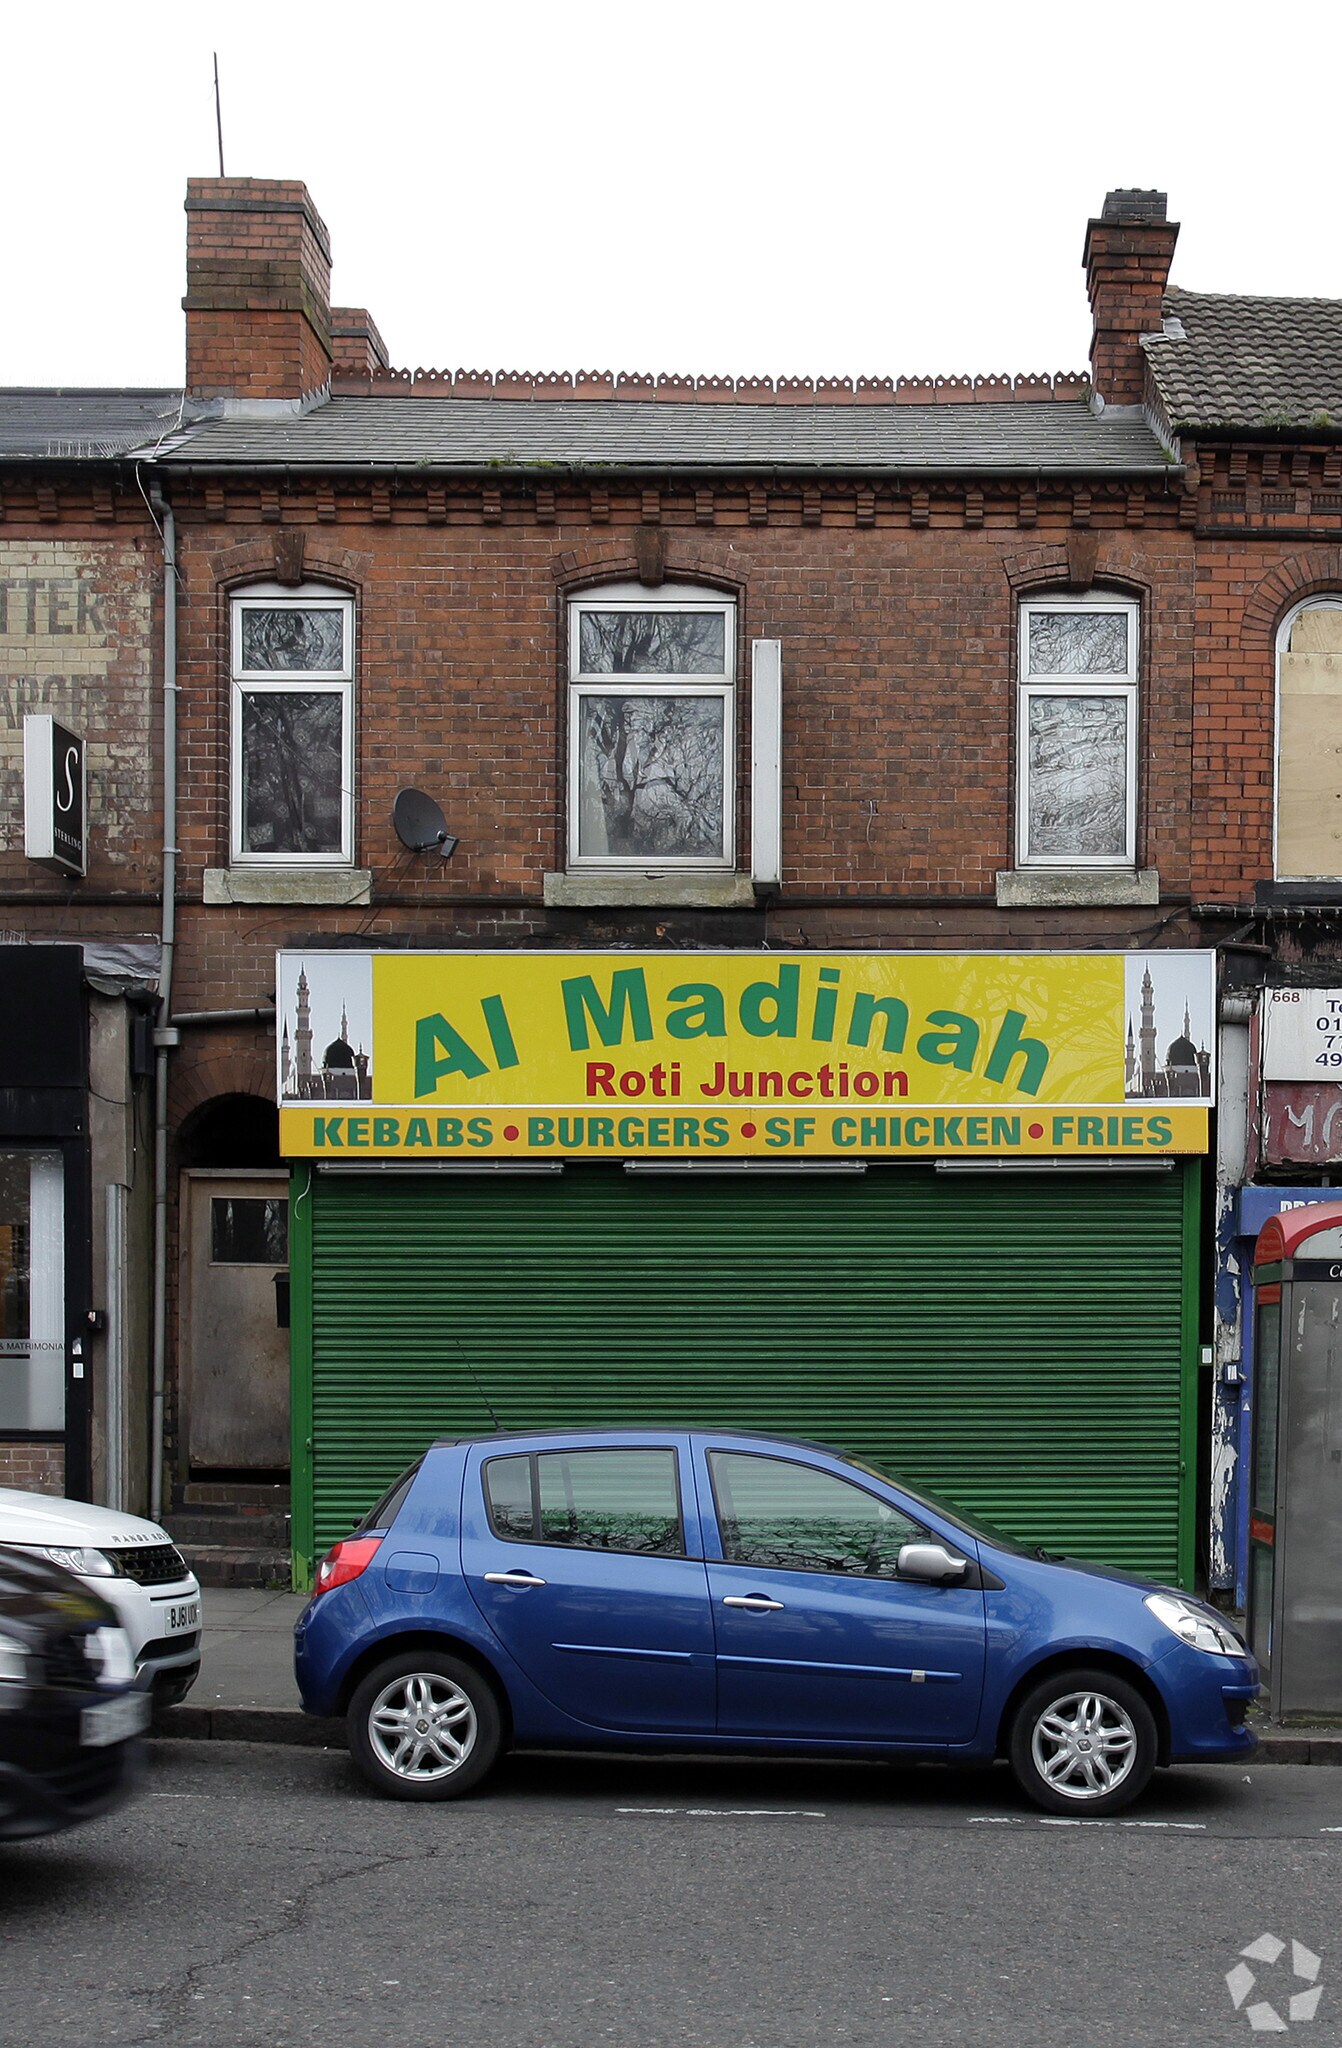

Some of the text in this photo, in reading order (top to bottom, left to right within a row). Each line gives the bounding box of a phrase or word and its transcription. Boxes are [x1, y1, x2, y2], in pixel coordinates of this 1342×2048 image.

[57, 746, 79, 812] S
[54, 827, 82, 851] STERLING
[1272, 991, 1300, 1003] 668
[414, 964, 1049, 1098] Al Madinah
[587, 1062, 908, 1097] Roti Junction
[314, 1117, 1172, 1147] KEBABS BURGERS SF CHICKEN FRIES
[111, 1533, 150, 1543] RANGE
